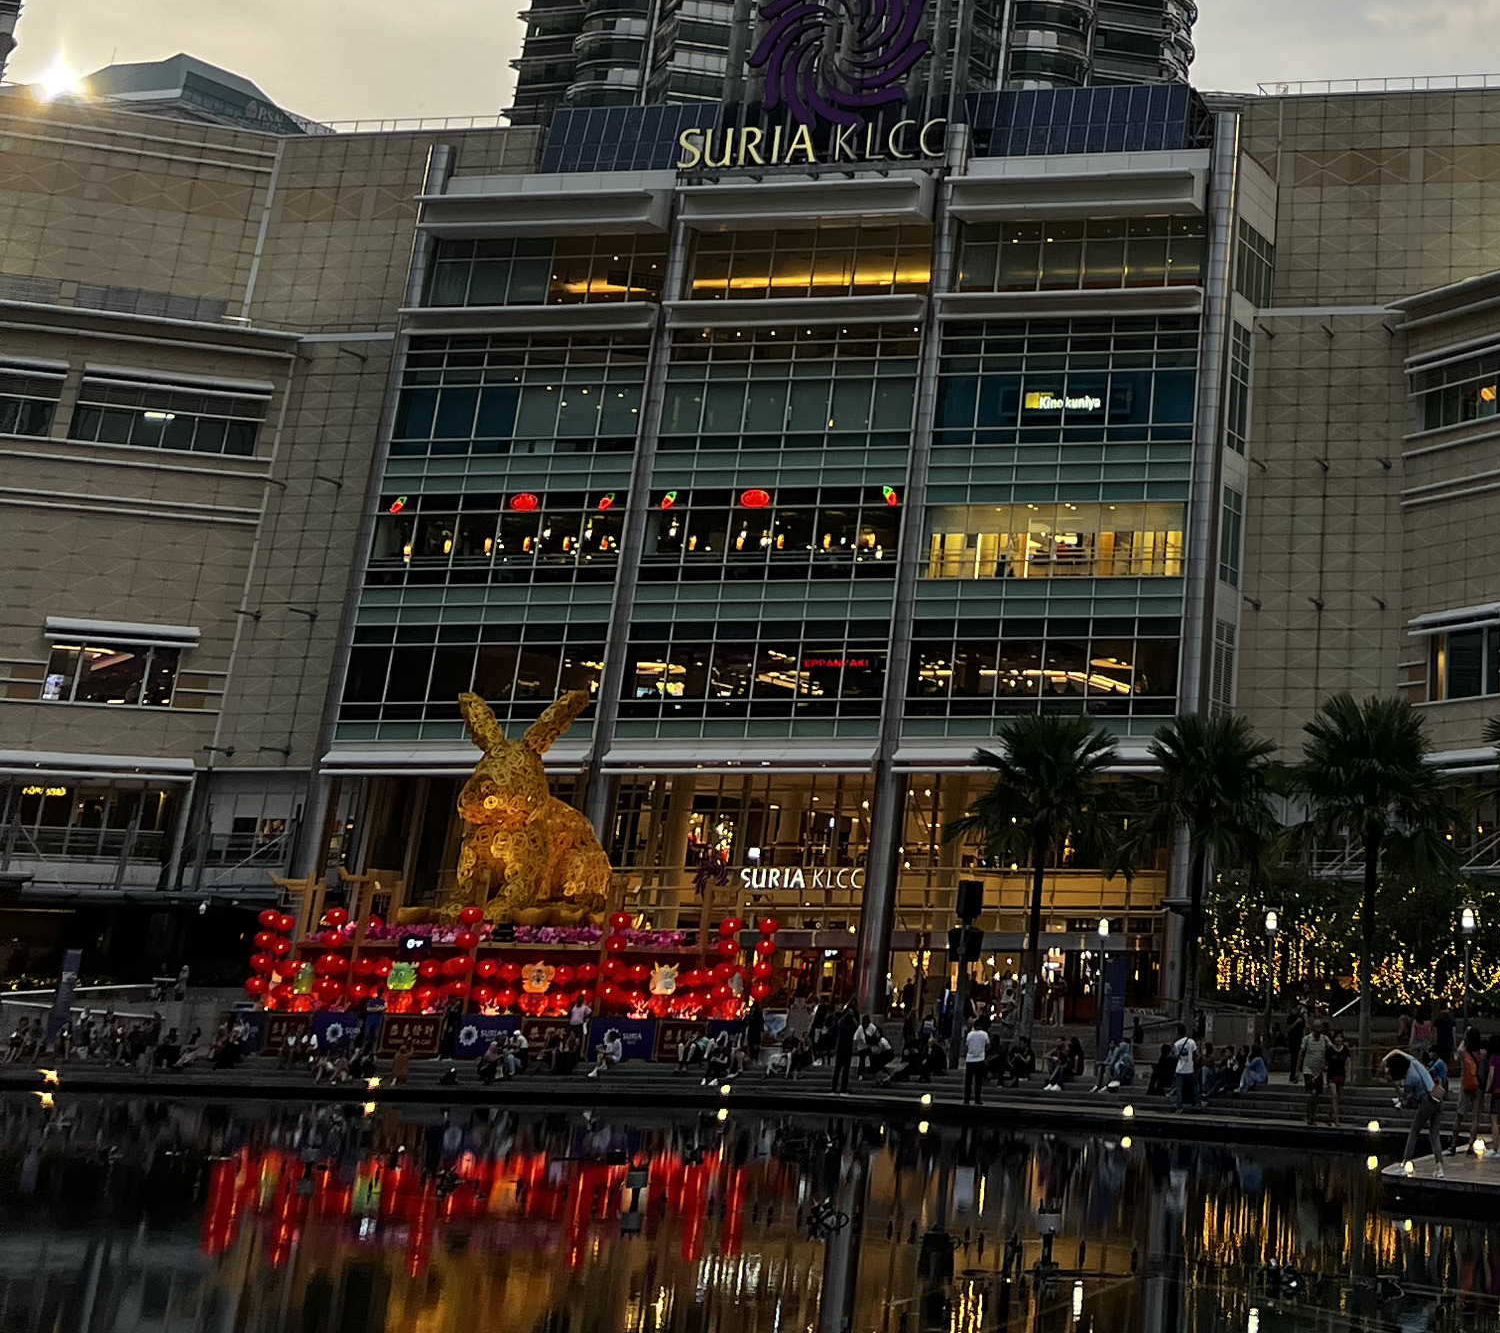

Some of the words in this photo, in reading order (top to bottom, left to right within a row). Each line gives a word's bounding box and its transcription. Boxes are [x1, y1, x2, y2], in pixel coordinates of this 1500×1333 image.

[677, 124, 816, 168] SURIA
[835, 118, 947, 161] KLCC
[740, 868, 806, 889] SURIA
[812, 868, 865, 889] KLCC
